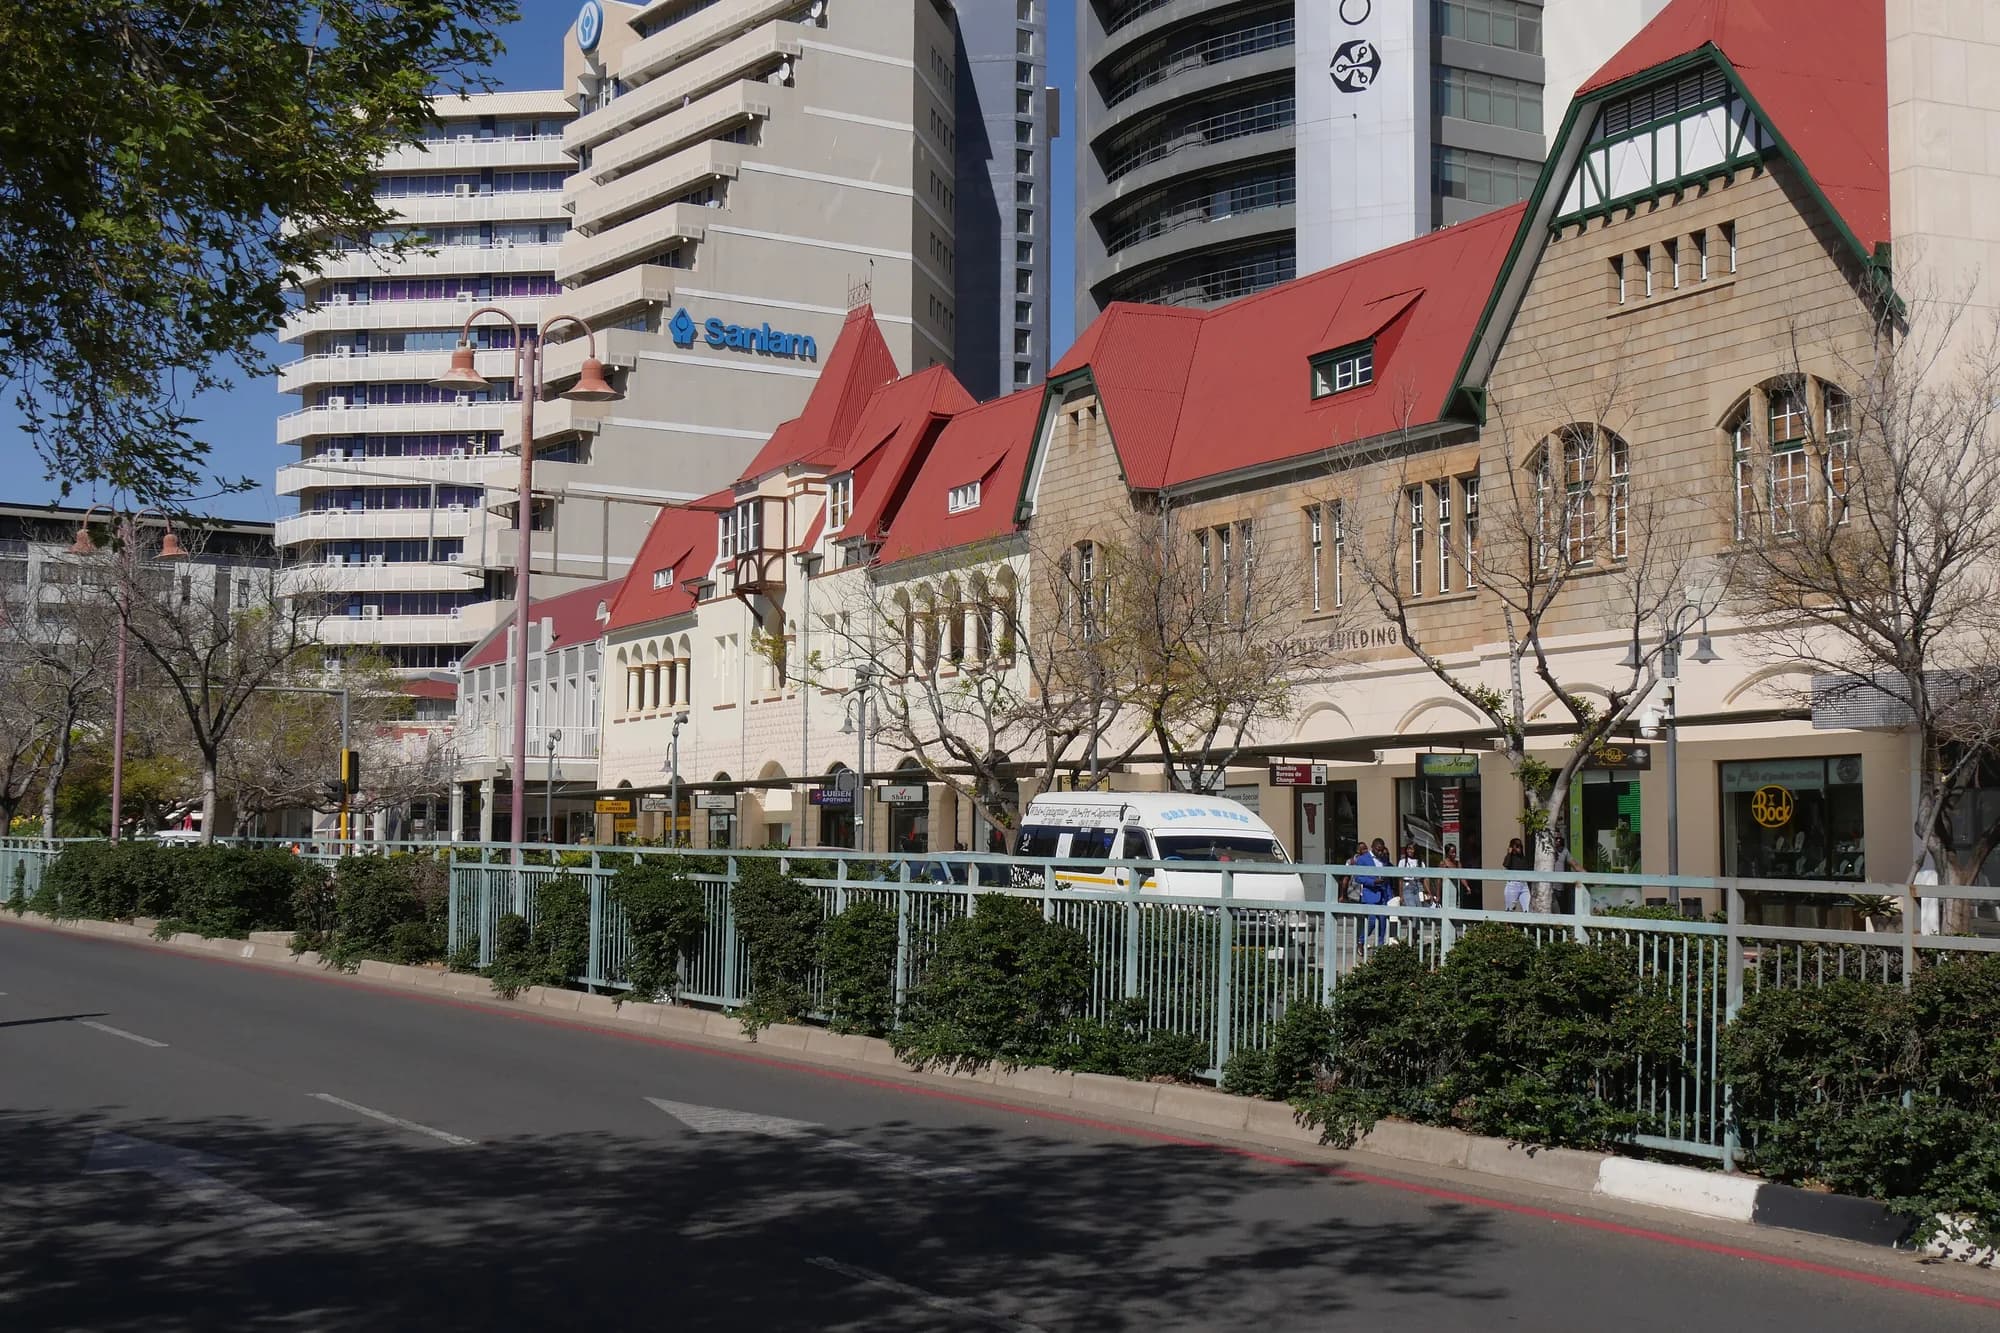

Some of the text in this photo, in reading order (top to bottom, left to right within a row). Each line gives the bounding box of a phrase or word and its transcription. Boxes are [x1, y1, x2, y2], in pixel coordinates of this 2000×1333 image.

[704, 317, 817, 357] Sanlam
[1328, 626, 1397, 650] BUILDING
[1757, 790, 1790, 824] Bock
